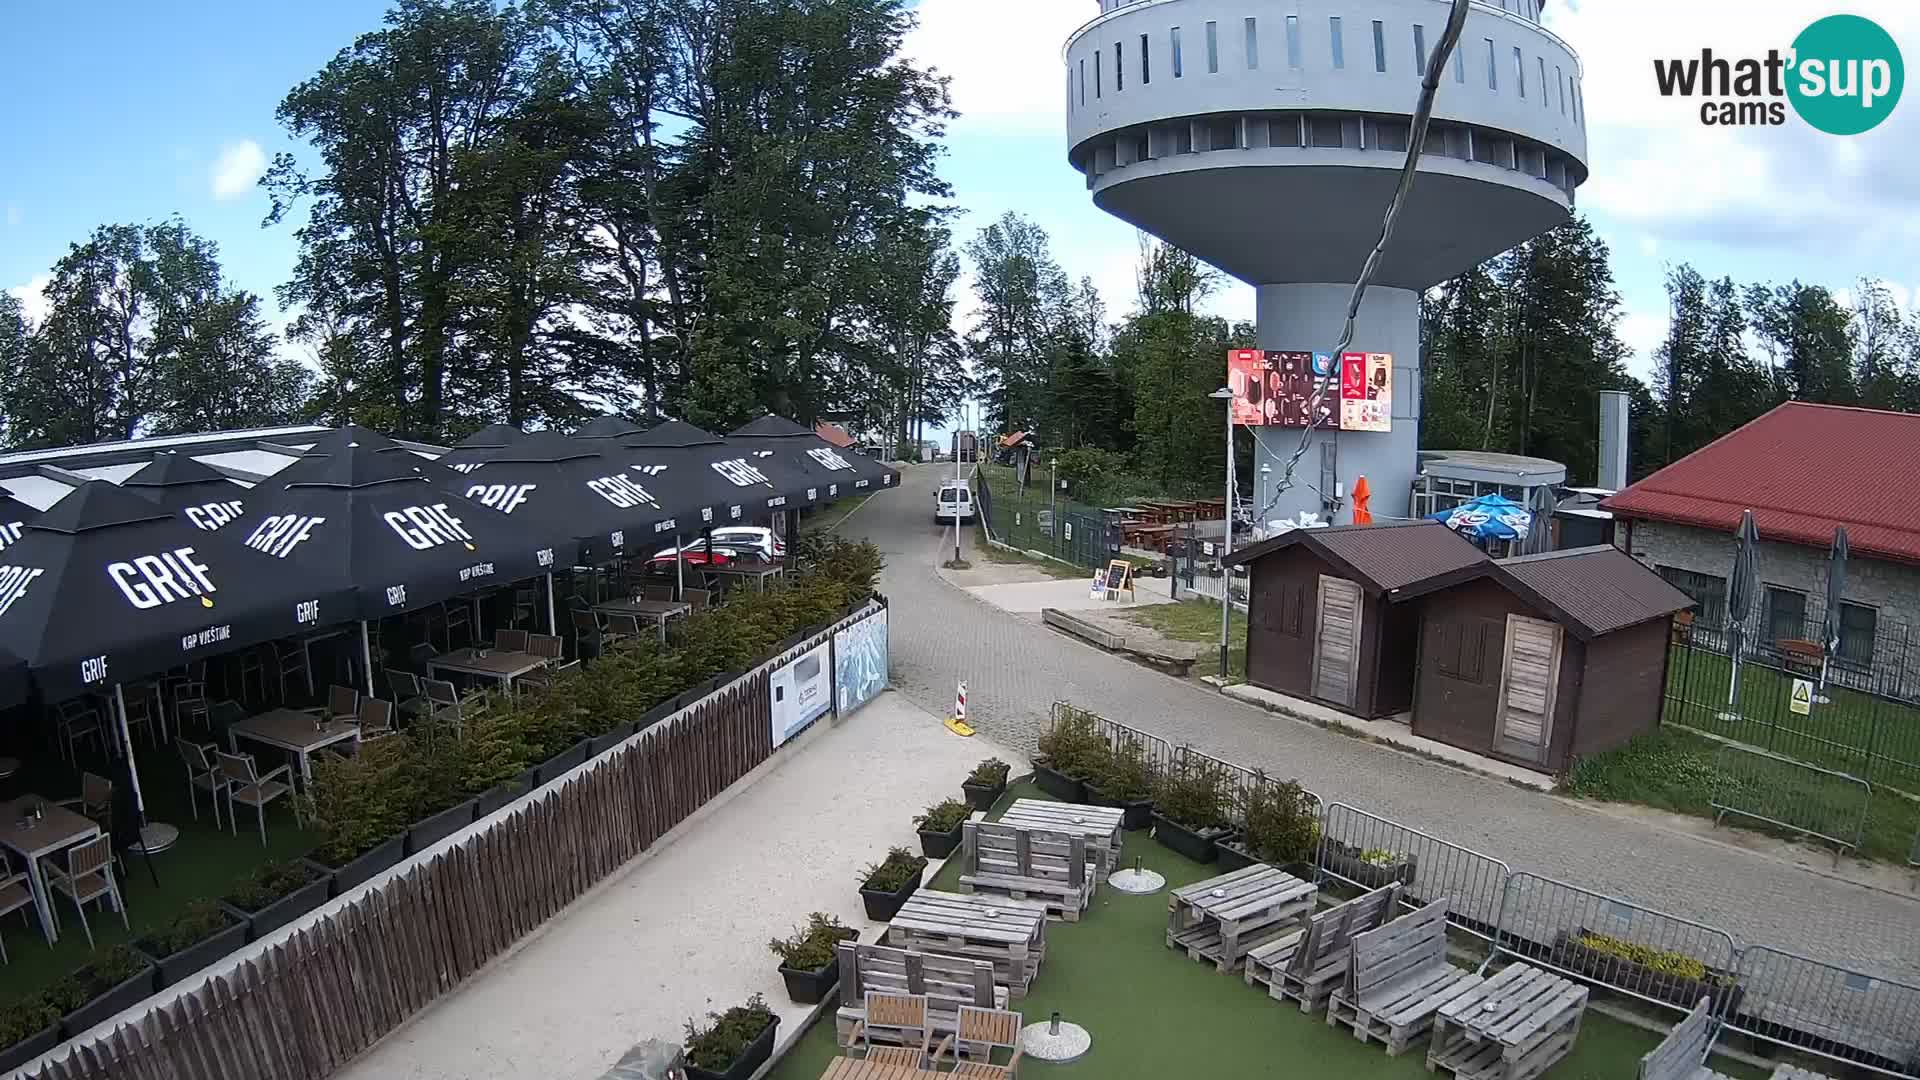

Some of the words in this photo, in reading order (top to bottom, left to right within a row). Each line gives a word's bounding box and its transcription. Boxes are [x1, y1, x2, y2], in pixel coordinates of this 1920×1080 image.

[711, 458, 769, 487] GRIF
[586, 473, 656, 508] GRIF
[244, 514, 326, 558] GRIF
[384, 503, 472, 550] GRIF
[107, 547, 217, 609] GRIF
[386, 584, 406, 607] GRIF
[296, 599, 320, 624] GRIF
[182, 633, 198, 651] KAP
[81, 655, 108, 684] GRIF
